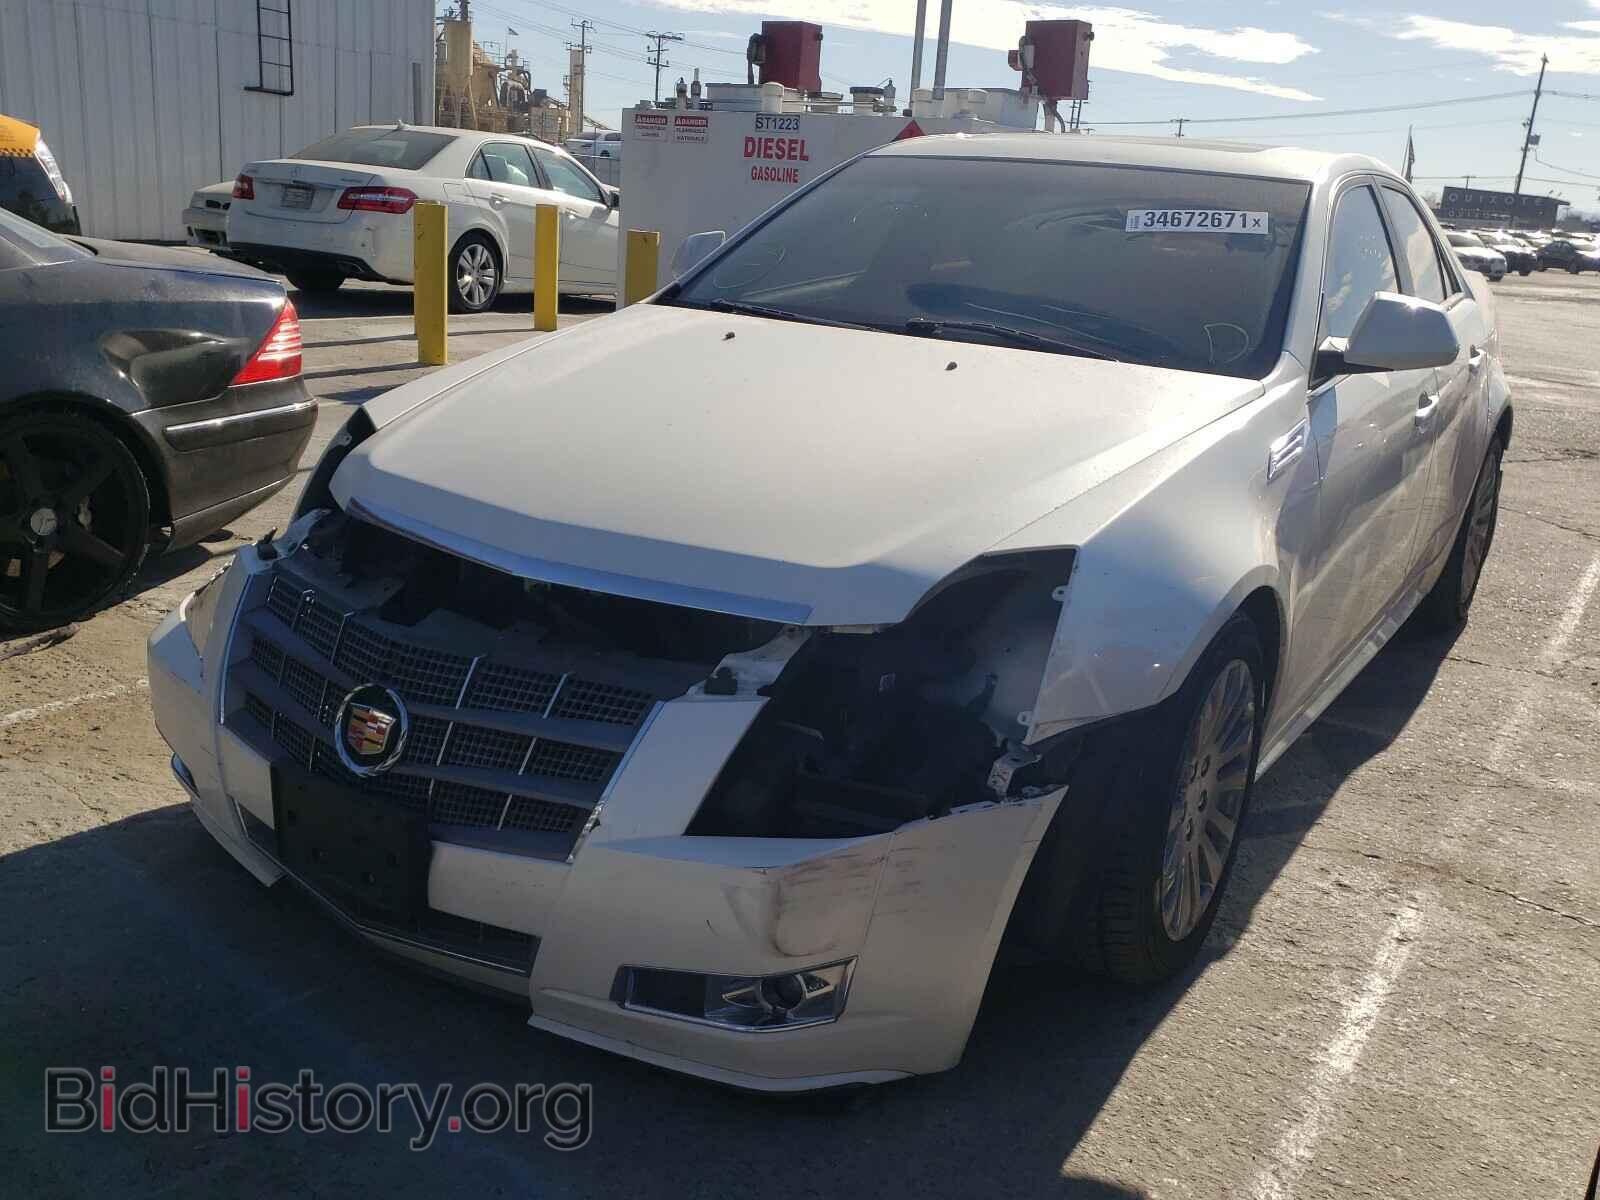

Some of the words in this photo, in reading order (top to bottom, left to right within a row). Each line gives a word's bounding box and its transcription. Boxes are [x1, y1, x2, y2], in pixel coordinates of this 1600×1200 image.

[681, 118, 707, 126] DANGER
[755, 117, 799, 130] ST1223
[743, 136, 809, 161] DIESEL
[751, 165, 799, 183] GASOLINE
[1448, 192, 1545, 206] QUIXOTE
[1143, 211, 1248, 228] 34672671
